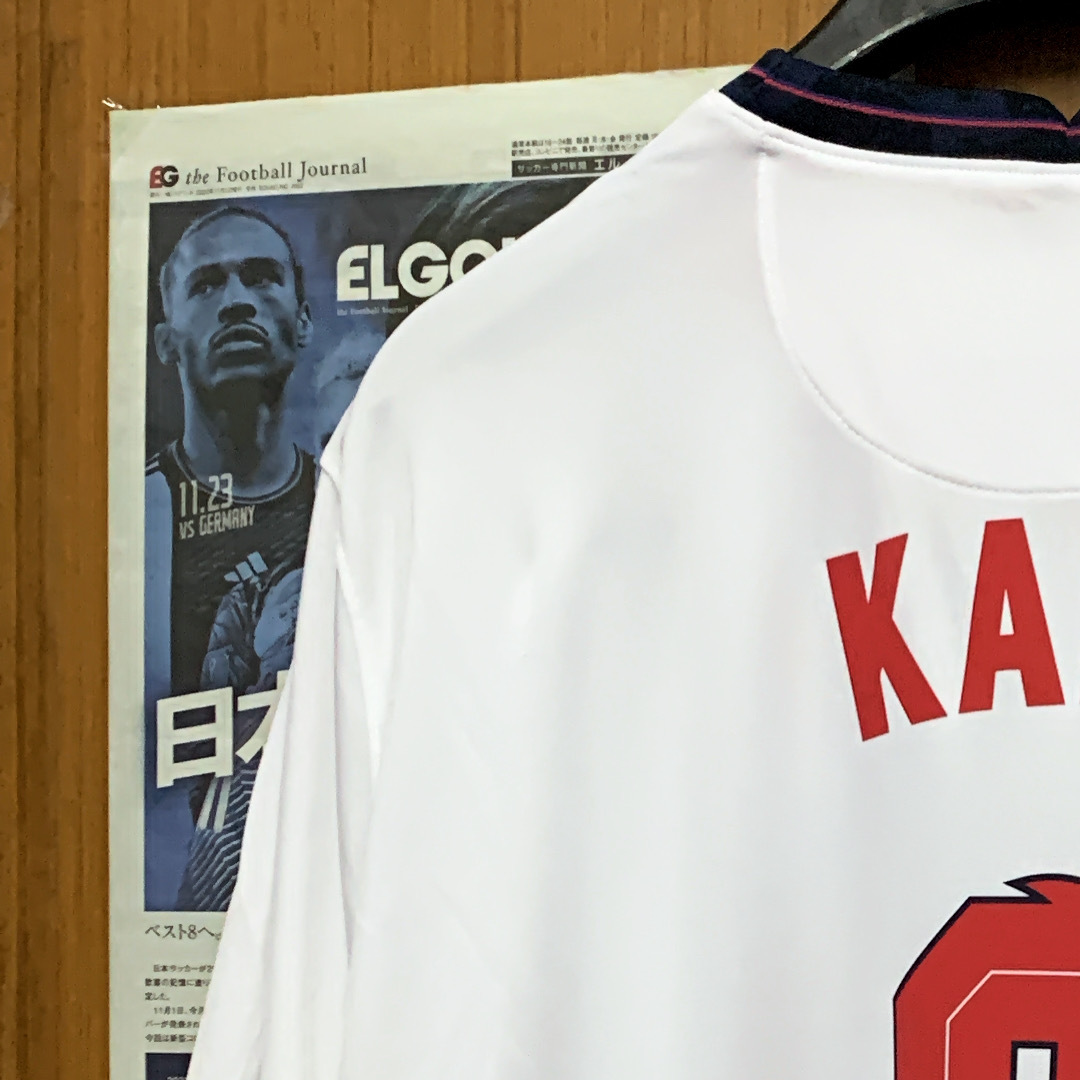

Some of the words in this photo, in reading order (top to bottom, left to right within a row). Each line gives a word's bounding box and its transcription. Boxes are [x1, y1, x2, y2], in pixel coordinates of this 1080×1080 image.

[186, 168, 209, 185] the
[217, 162, 292, 183] Football
[297, 157, 367, 182] Journal
[179, 473, 234, 517] 11.23
[179, 521, 195, 540] VS
[199, 504, 256, 536] GERMANY
